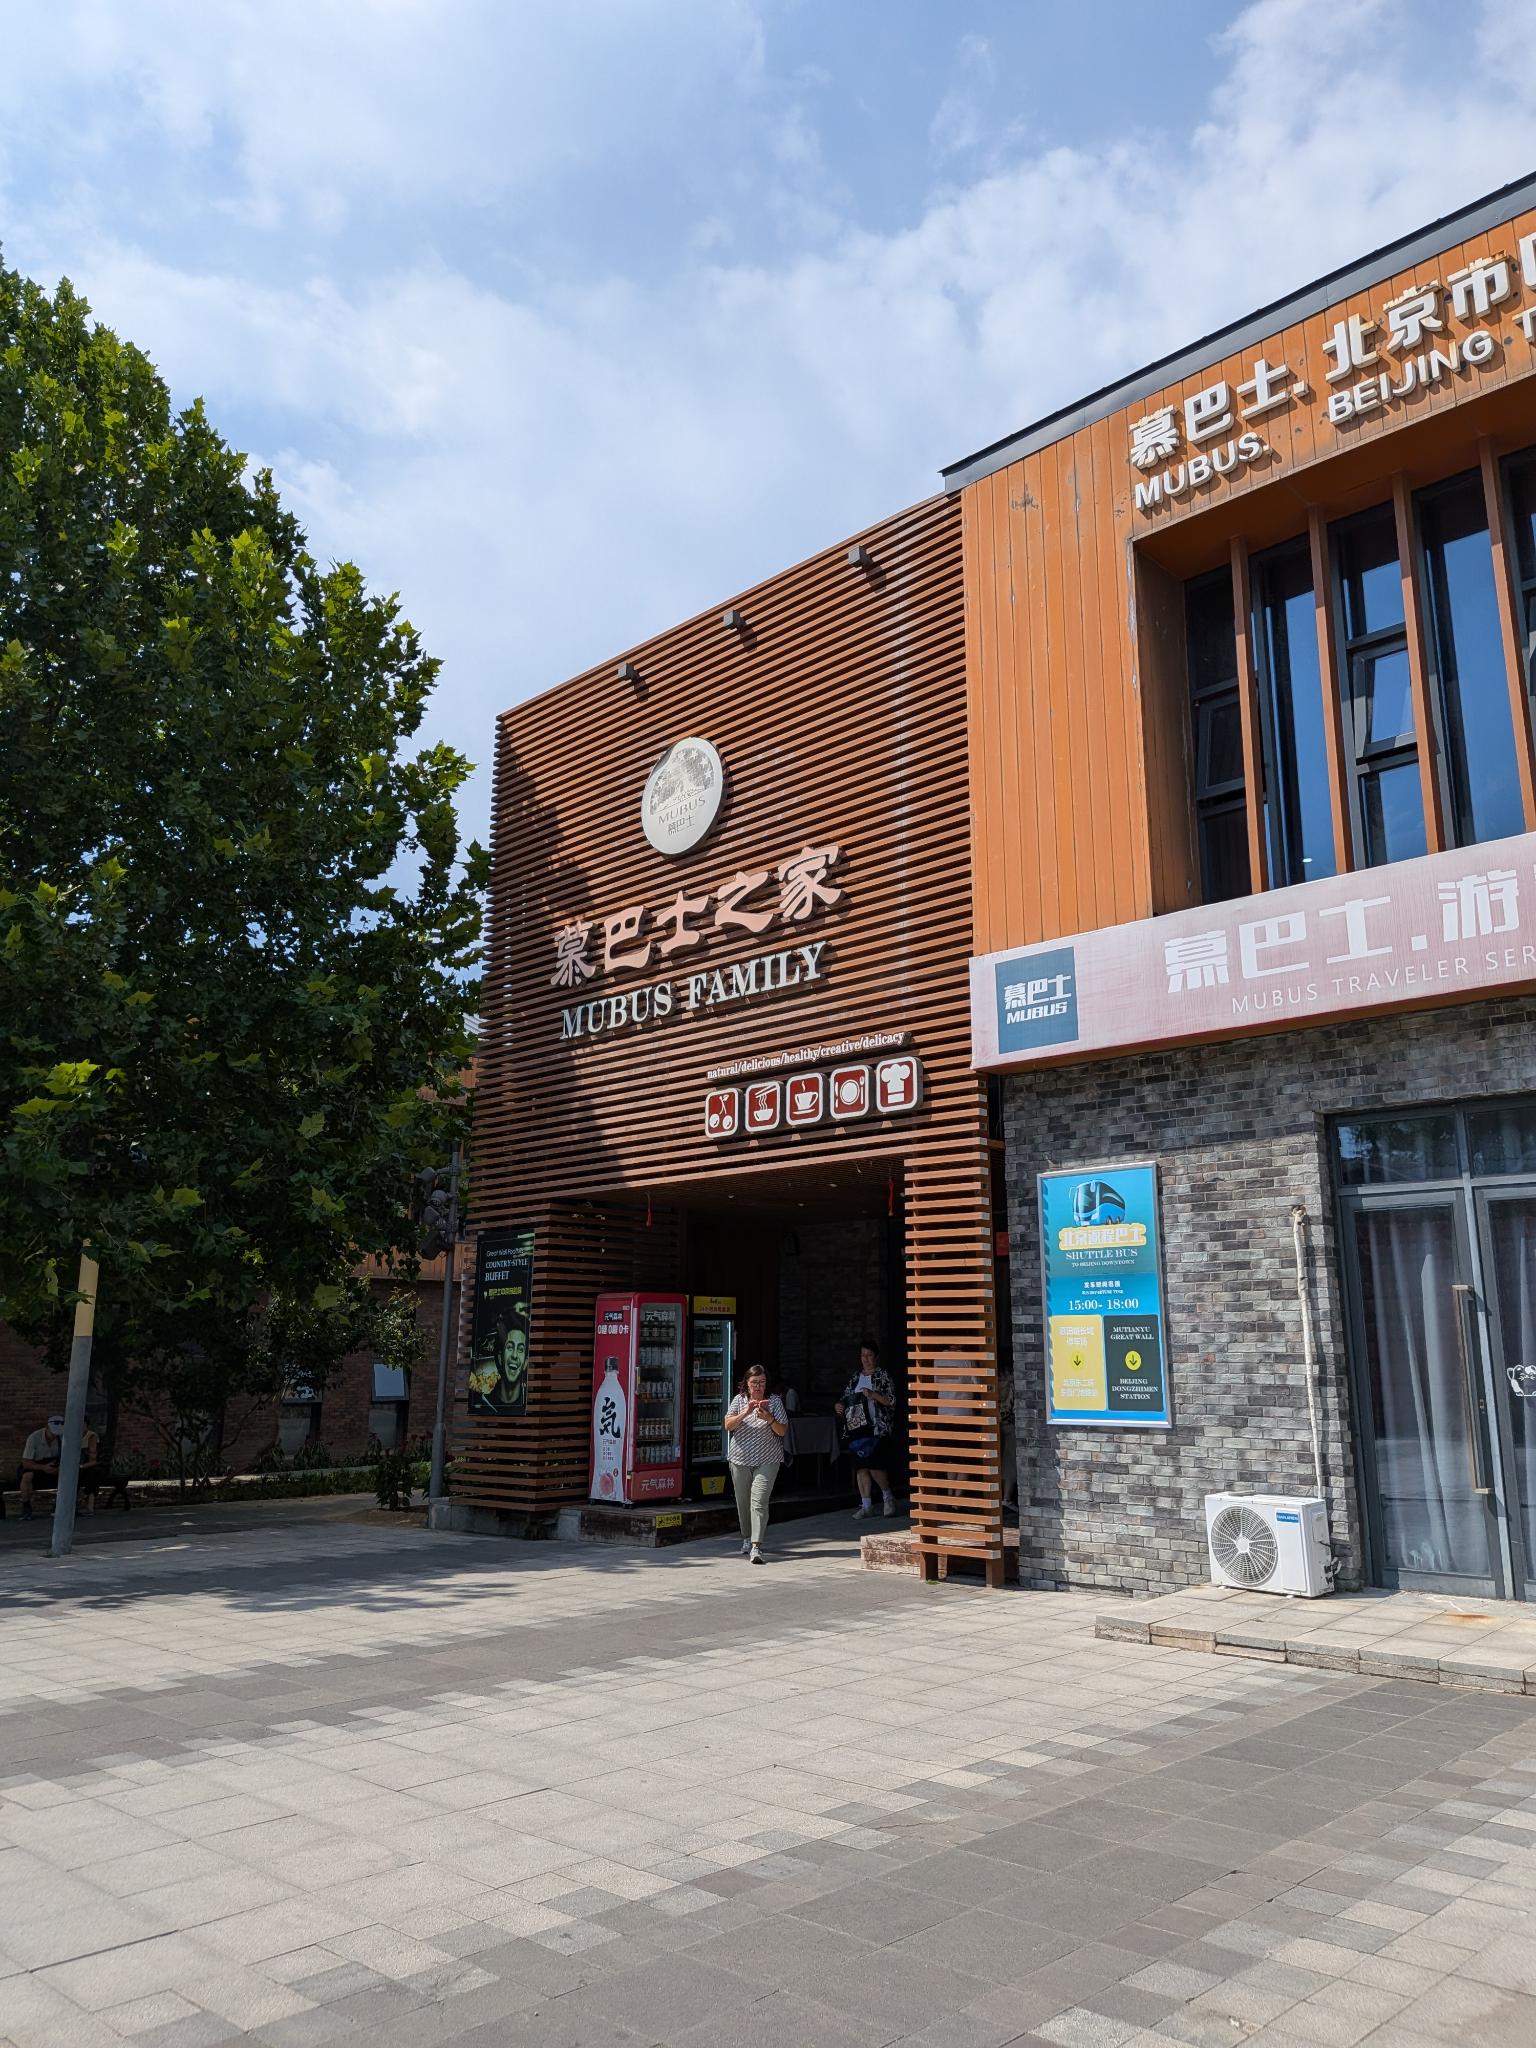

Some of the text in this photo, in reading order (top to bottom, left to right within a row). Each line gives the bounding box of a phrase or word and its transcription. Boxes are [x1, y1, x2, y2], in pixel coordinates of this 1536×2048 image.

[1328, 330, 1493, 426] BEIJING
[658, 796, 706, 824] MUBUS
[550, 845, 842, 987] 慕巴士之家
[559, 940, 828, 1040] MUBUS FAMILY
[1004, 973, 1072, 1010] 慕巴士
[1232, 984, 1318, 1013] MUBUS
[1332, 956, 1470, 996] TRAVELER
[1006, 1002, 1068, 1025] MUBUS
[1065, 1248, 1138, 1260] SHUTTLE BUS
[485, 1270, 510, 1281] BUFFET
[1106, 1298, 1139, 1310] 18:00
